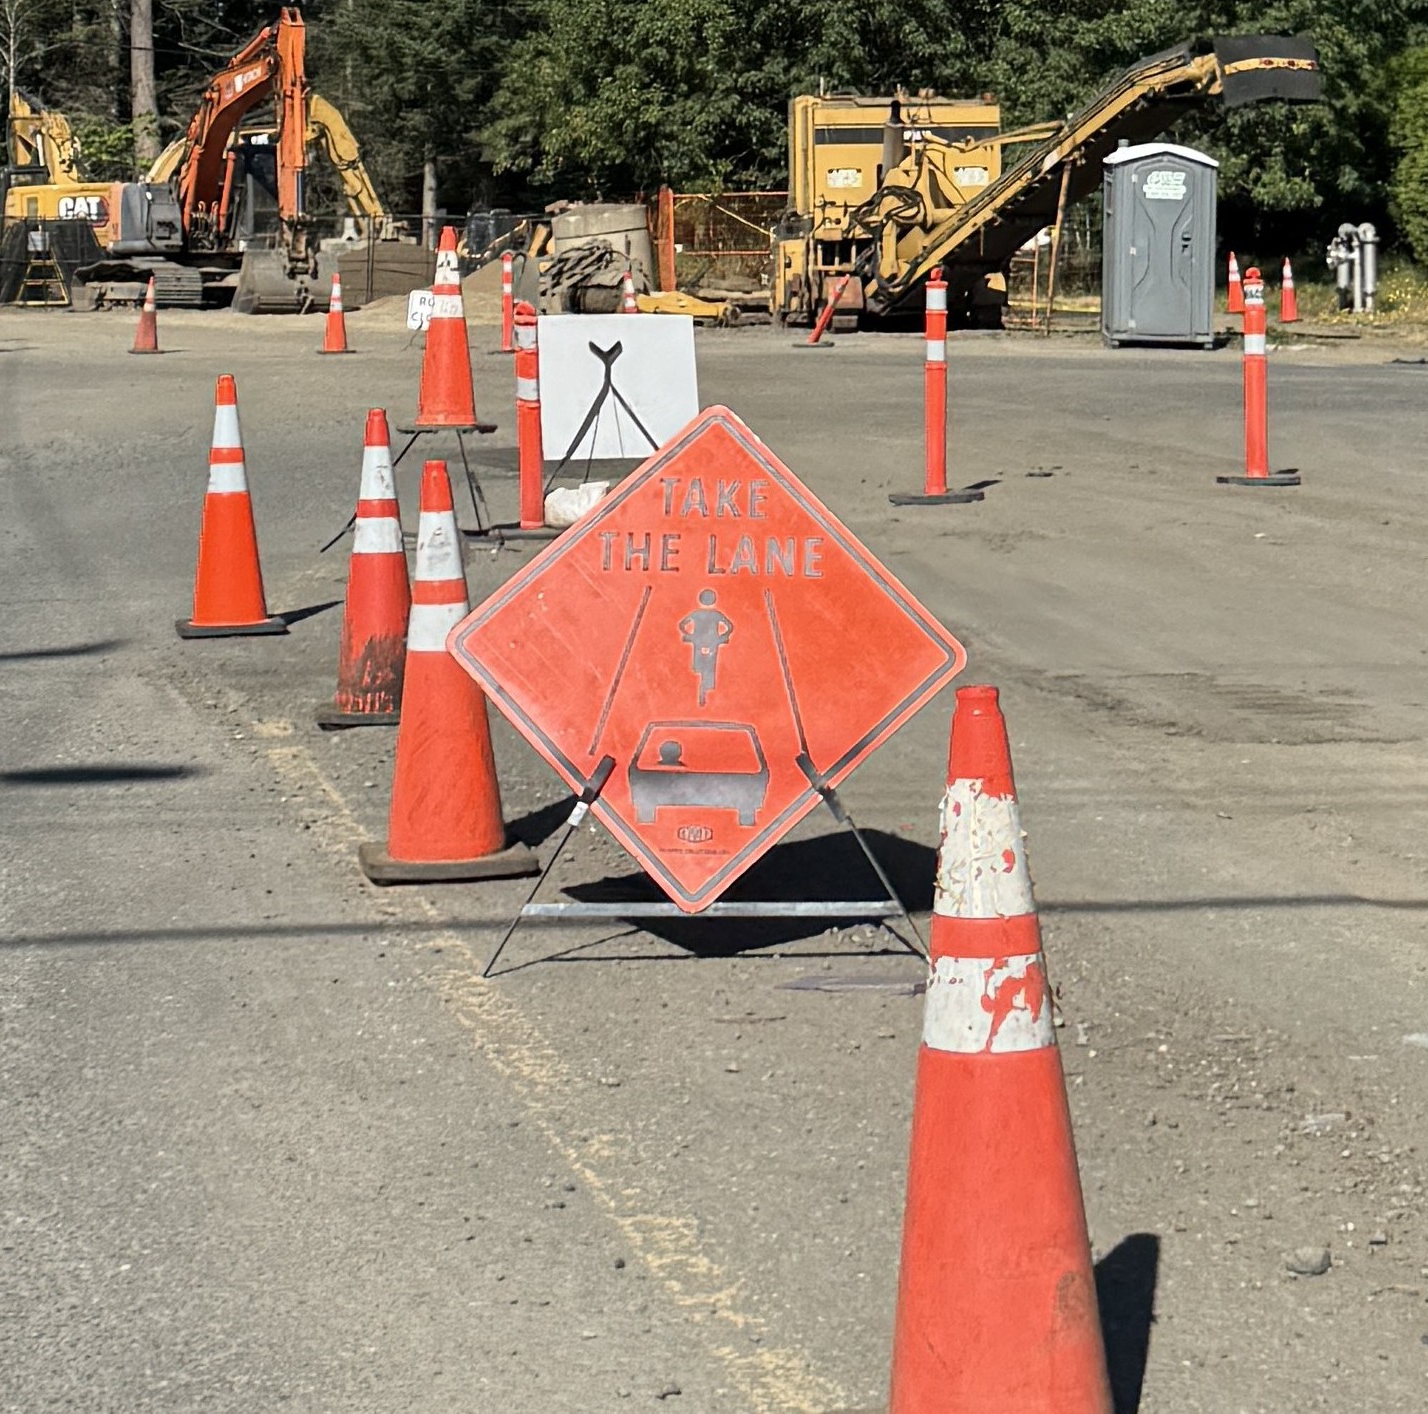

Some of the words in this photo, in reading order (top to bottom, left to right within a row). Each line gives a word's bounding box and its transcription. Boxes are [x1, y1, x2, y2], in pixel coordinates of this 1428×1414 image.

[58, 195, 101, 220] CAT
[659, 477, 770, 519] TAKE
[598, 531, 681, 572] THE
[707, 533, 825, 578] LANE
